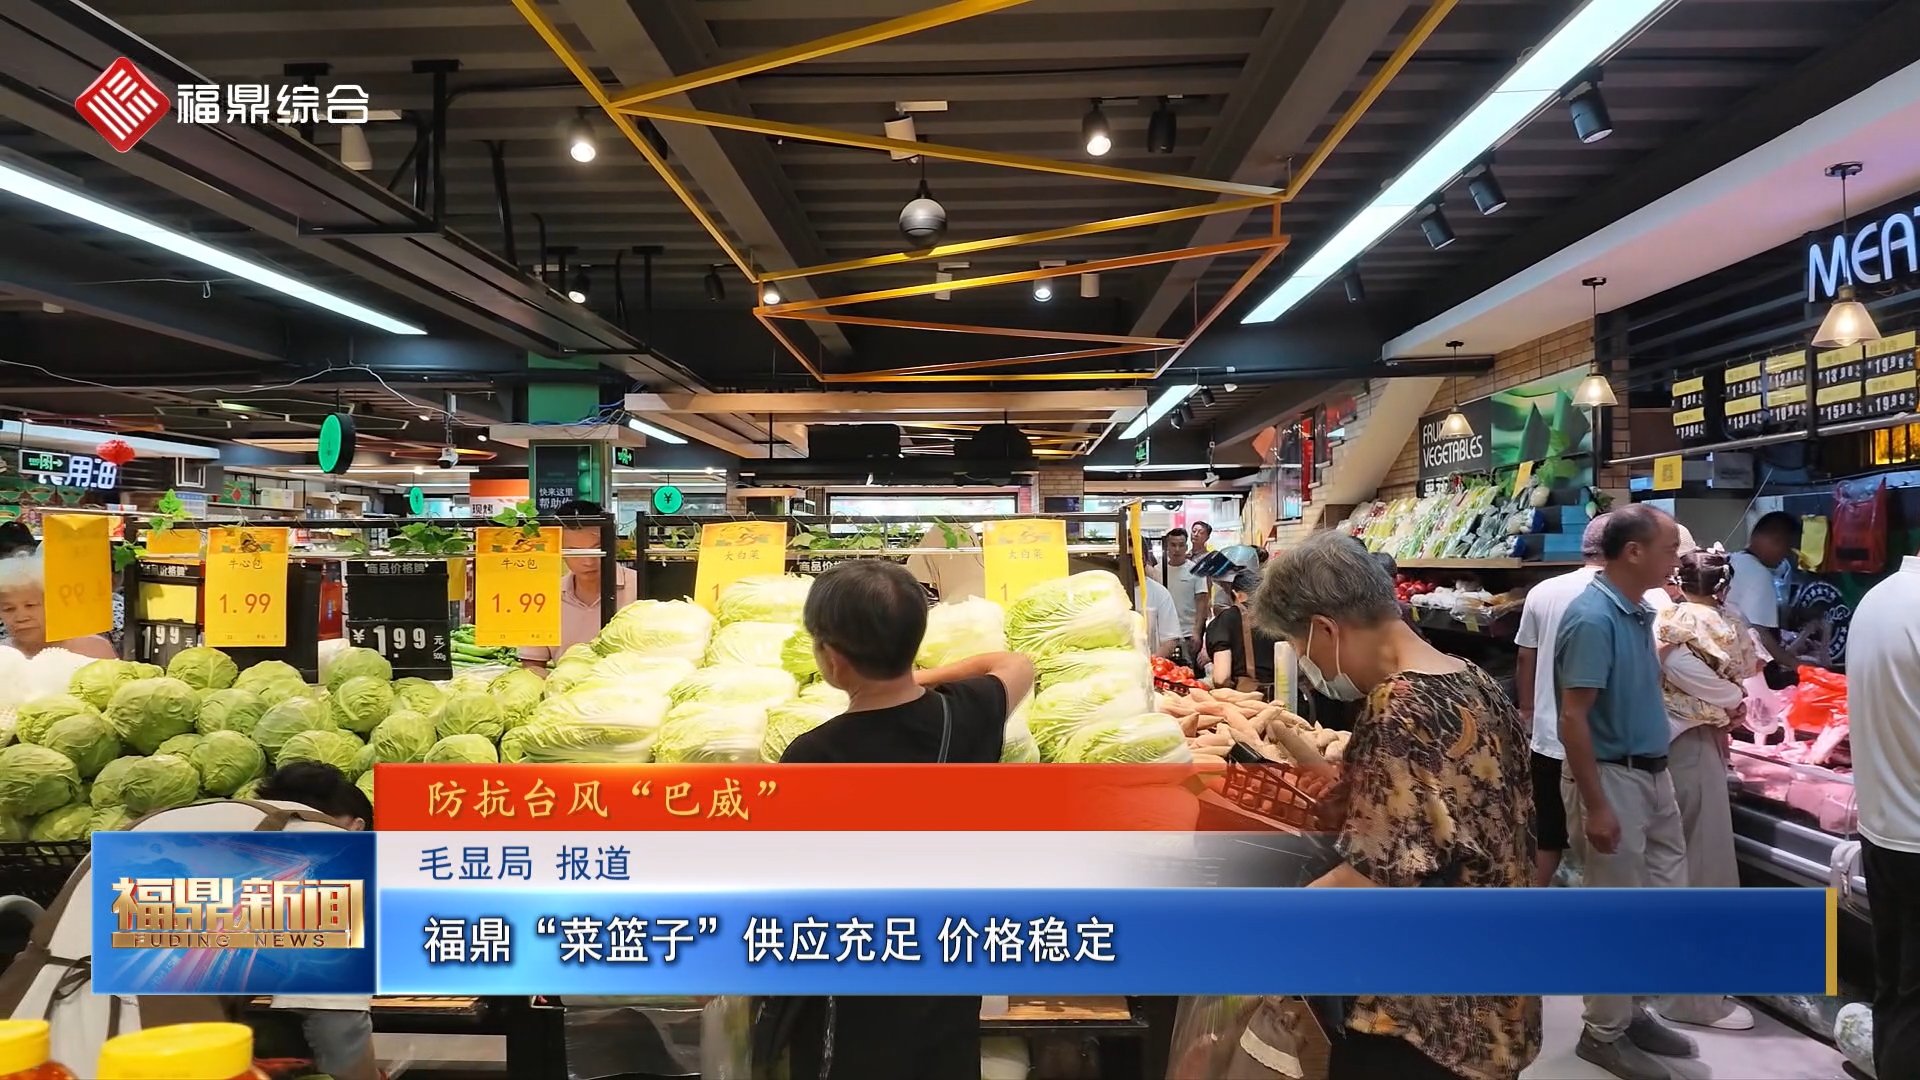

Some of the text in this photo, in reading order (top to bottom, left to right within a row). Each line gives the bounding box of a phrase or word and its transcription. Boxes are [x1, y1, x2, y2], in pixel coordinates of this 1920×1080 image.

[1808, 205, 1920, 303] MEA
[1423, 420, 1447, 445] FRUI
[1423, 435, 1483, 468] VEGETABLES
[38, 456, 118, 490] 用油
[539, 487, 573, 497] 快来这里
[228, 558, 263, 570] 牛心包
[500, 558, 538, 570] 牛心包
[724, 550, 760, 561] 大白菜
[1008, 549, 1044, 560] 大白菜
[366, 562, 426, 574] 商品价格牌
[219, 593, 271, 614] 1.99
[492, 593, 546, 613] 1.99
[373, 625, 427, 659] 1.99
